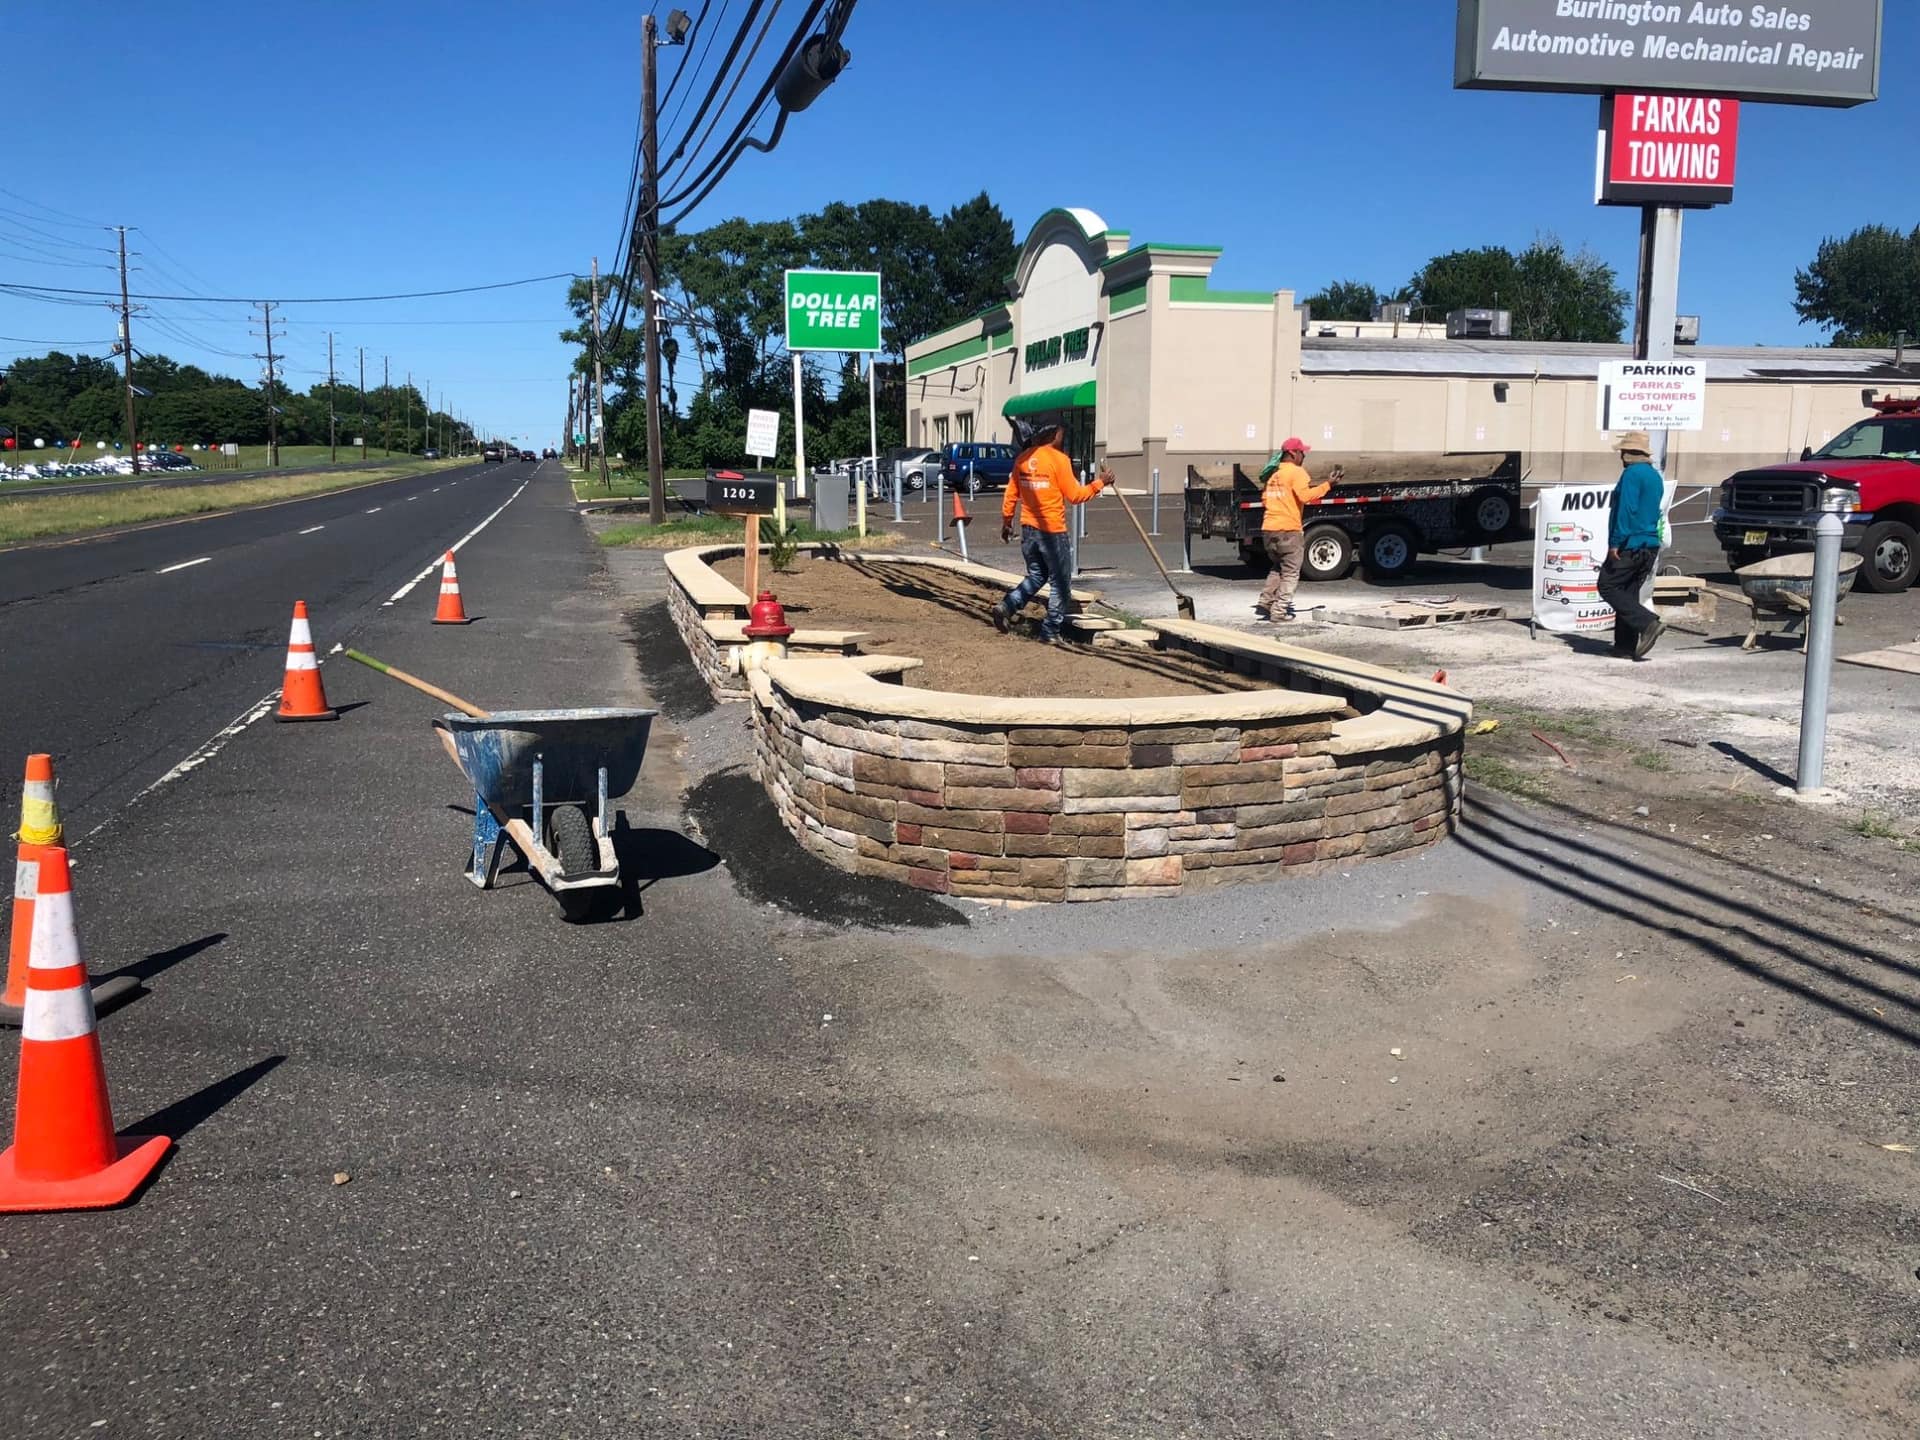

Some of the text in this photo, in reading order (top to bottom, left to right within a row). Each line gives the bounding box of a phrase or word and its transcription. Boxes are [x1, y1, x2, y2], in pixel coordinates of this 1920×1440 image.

[1556, 0, 1811, 31] Burlington Auto Sales
[1492, 27, 1864, 72] Automotive Mechanical Repair
[1631, 95, 1721, 136] FARKAS
[1629, 140, 1720, 179] TOWING
[791, 293, 877, 311] DOLLAR
[806, 311, 862, 328] TREE
[1063, 327, 1090, 358] TREE
[1622, 366, 1696, 376] PARKING
[1618, 393, 1697, 401] CUSTOMERS
[1641, 404, 1674, 412] ONLY
[723, 487, 756, 500] 1202
